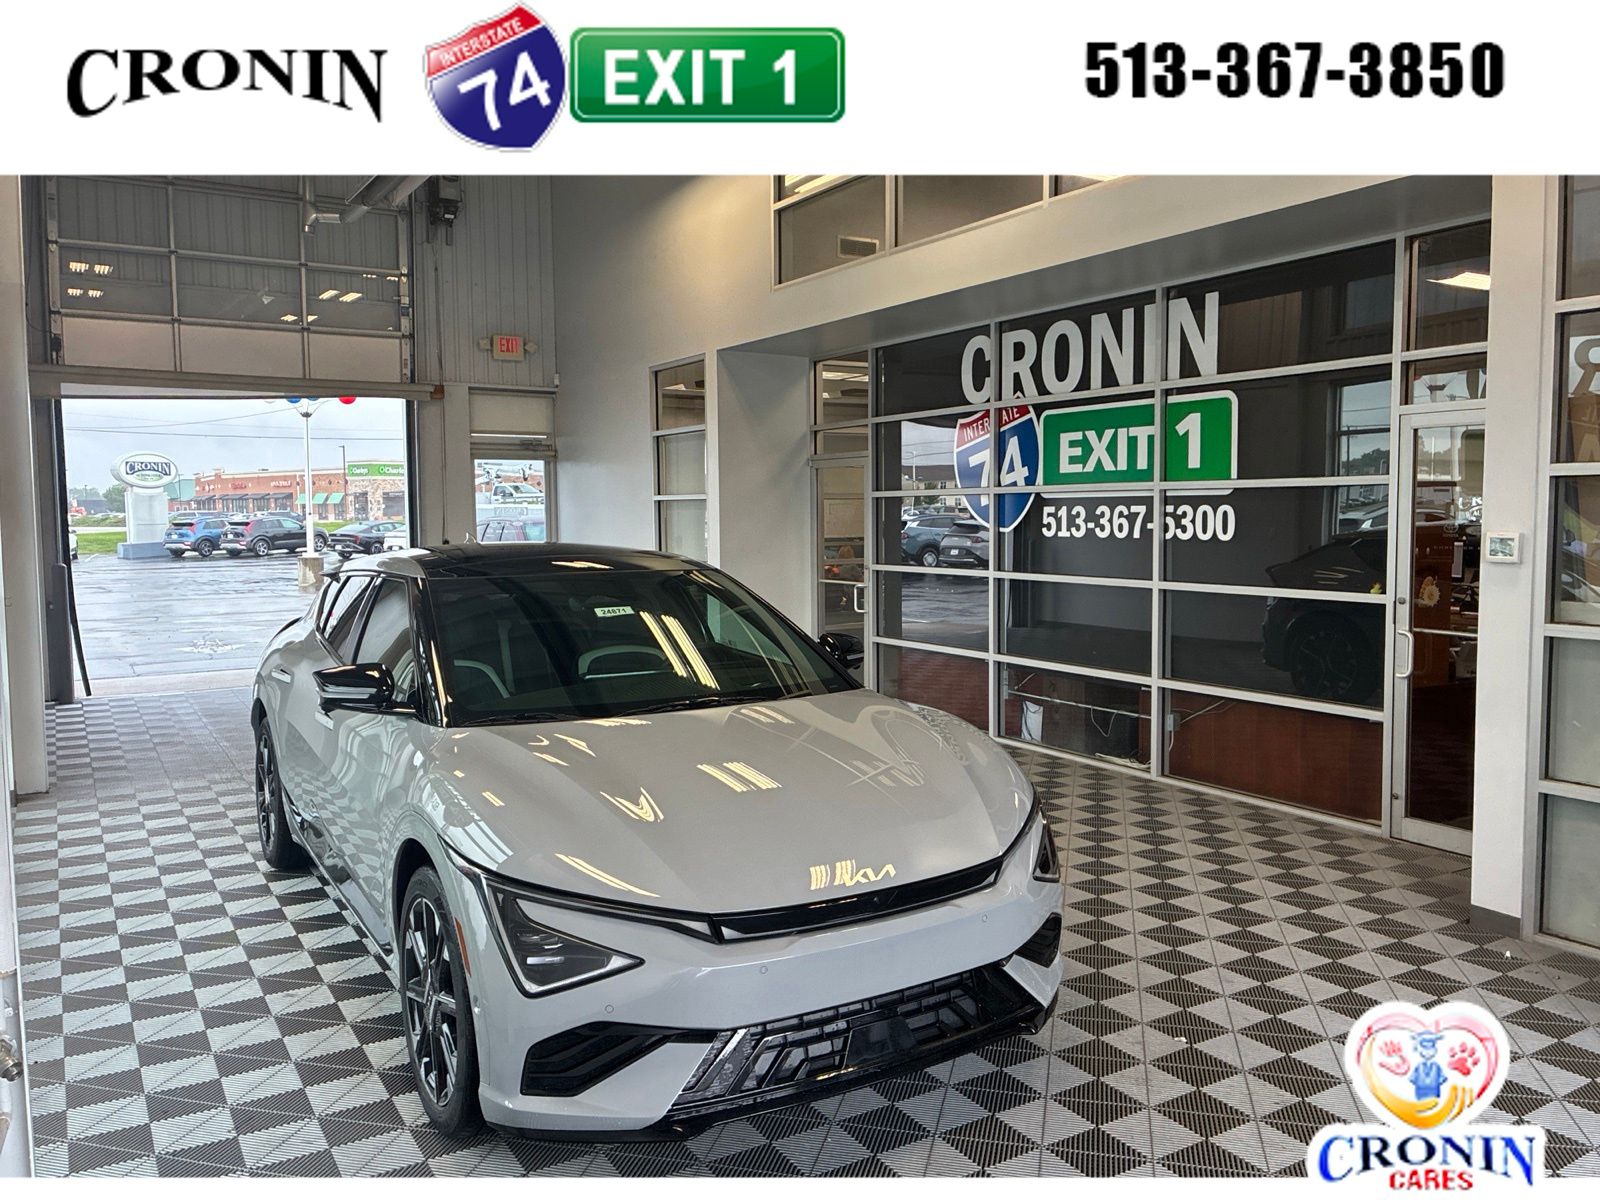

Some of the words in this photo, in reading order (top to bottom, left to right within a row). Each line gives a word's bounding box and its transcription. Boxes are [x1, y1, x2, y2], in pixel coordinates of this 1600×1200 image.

[499, 337, 520, 353] EXIT
[961, 291, 1220, 405] CRONIN
[963, 406, 1021, 442] INTERATE
[1059, 425, 1155, 474] EXIT
[1174, 412, 1202, 469] 1
[126, 462, 170, 475] CRONIN
[968, 435, 1030, 507] 74
[1041, 504, 1236, 542] 513-367-5300
